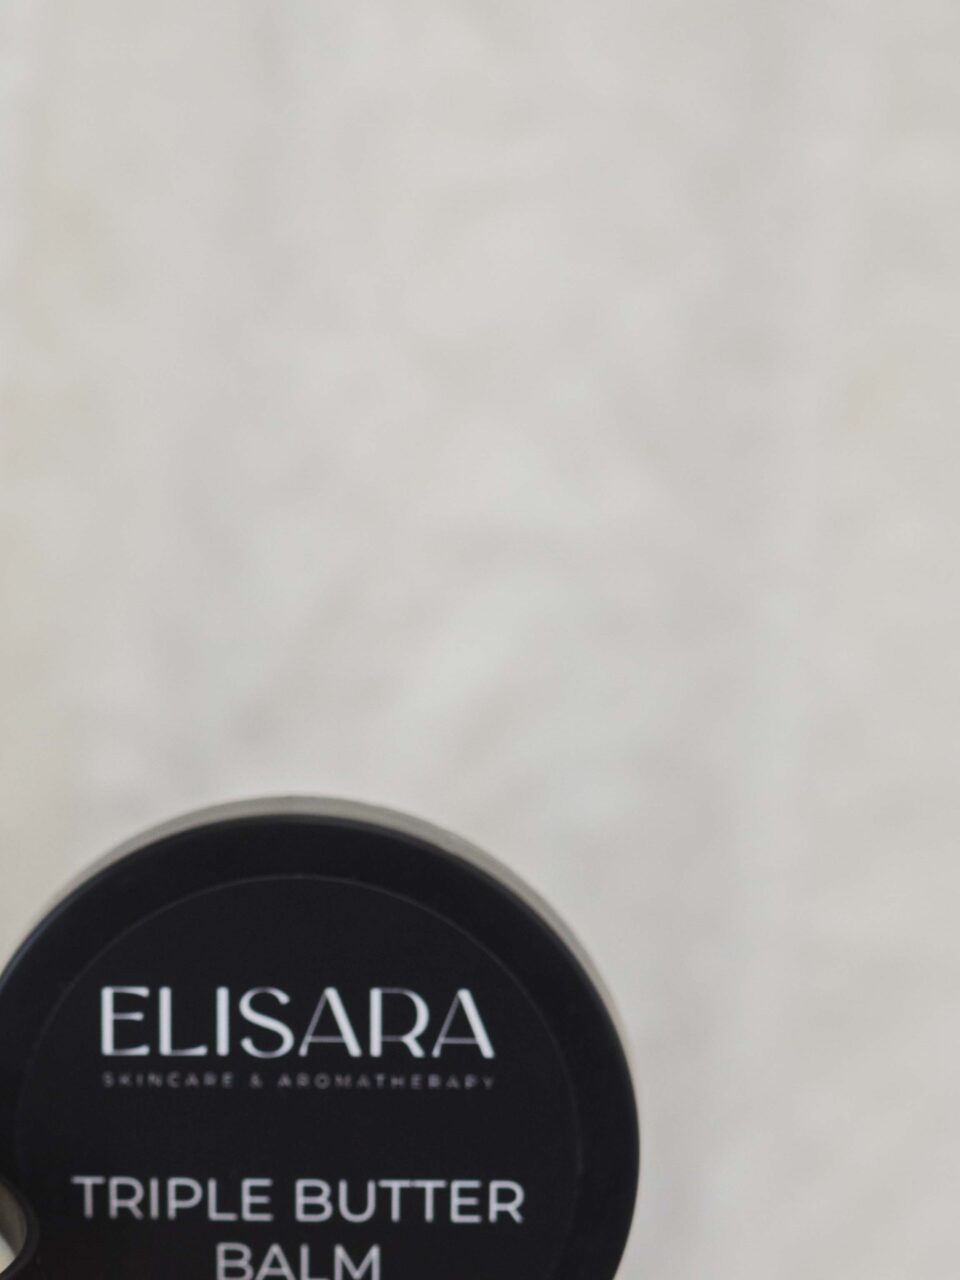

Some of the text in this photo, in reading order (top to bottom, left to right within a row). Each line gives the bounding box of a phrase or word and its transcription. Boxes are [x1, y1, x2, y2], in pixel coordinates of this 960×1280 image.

[100, 986, 496, 1059] ELISARA
[102, 1072, 234, 1089] SKINCARE
[277, 1072, 495, 1090] AROMATHERAPY
[72, 1175, 526, 1224] TRIPLE BUTTER
